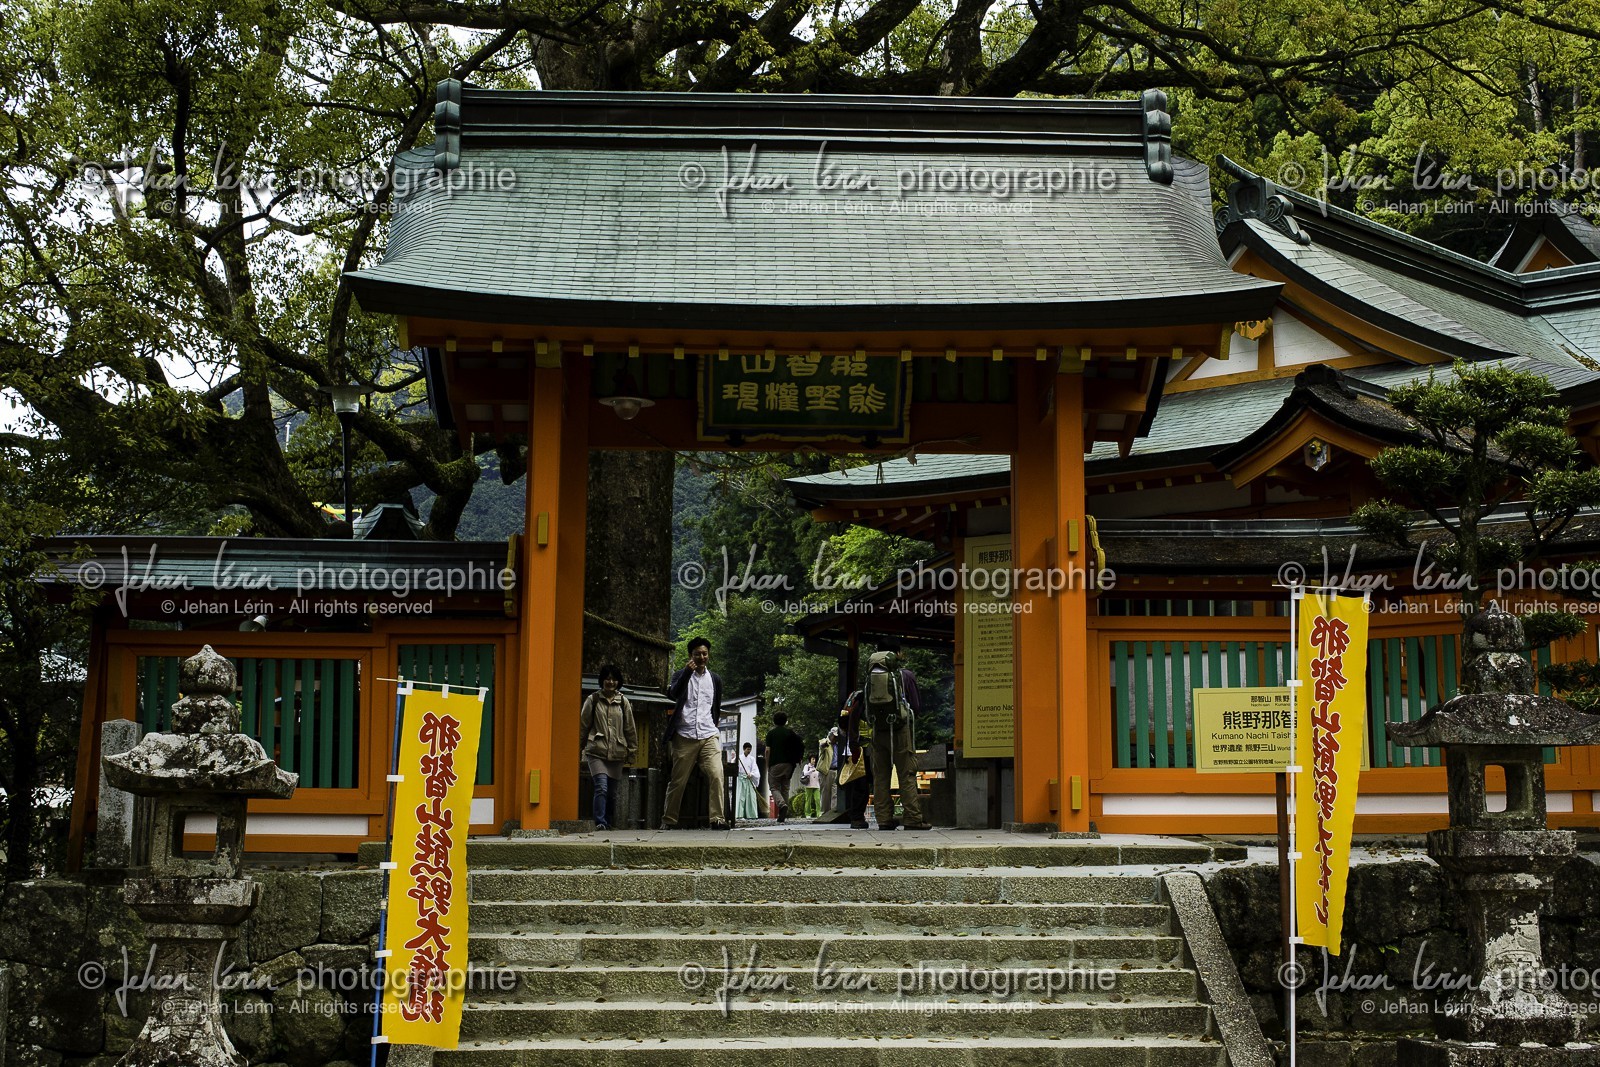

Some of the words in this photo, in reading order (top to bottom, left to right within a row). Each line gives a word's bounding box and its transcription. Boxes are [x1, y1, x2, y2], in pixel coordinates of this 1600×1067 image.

[978, 550, 1012, 564] 熊野那
[1222, 710, 1297, 729] 熊野那智
